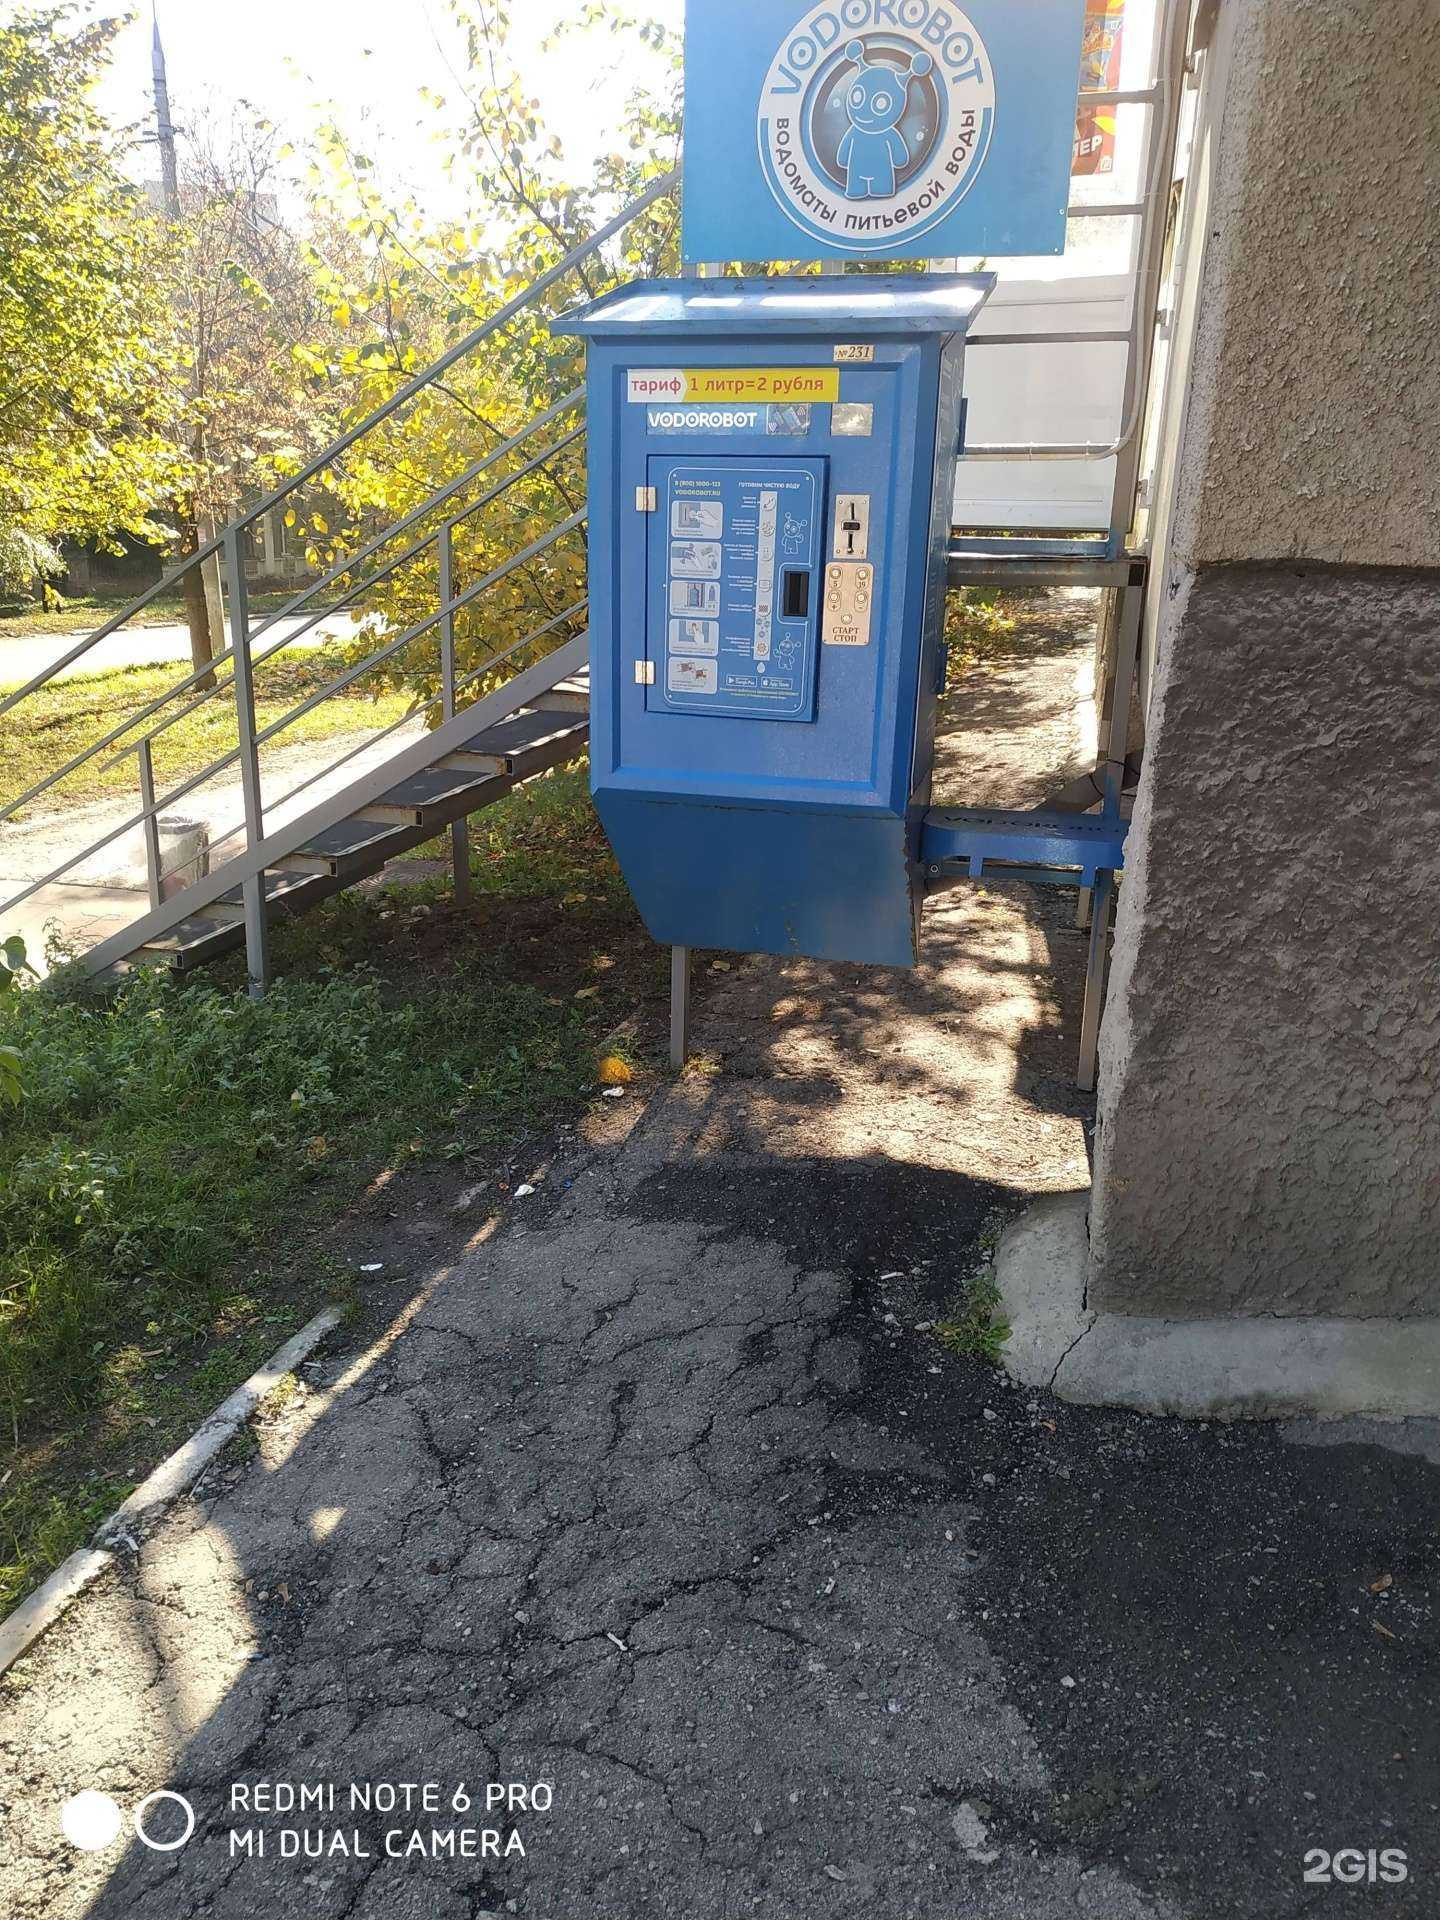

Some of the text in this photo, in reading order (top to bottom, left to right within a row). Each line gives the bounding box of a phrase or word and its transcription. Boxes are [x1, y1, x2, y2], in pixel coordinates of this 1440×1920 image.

[770, 0, 984, 94] VODOROBOT
[632, 376, 682, 395] тариф
[690, 377, 699, 391] 1
[772, 375, 824, 394] рубля
[647, 411, 758, 428] VODOROBOT
[832, 626, 860, 635] СТАРТ
[833, 634, 857, 642] СТОП
